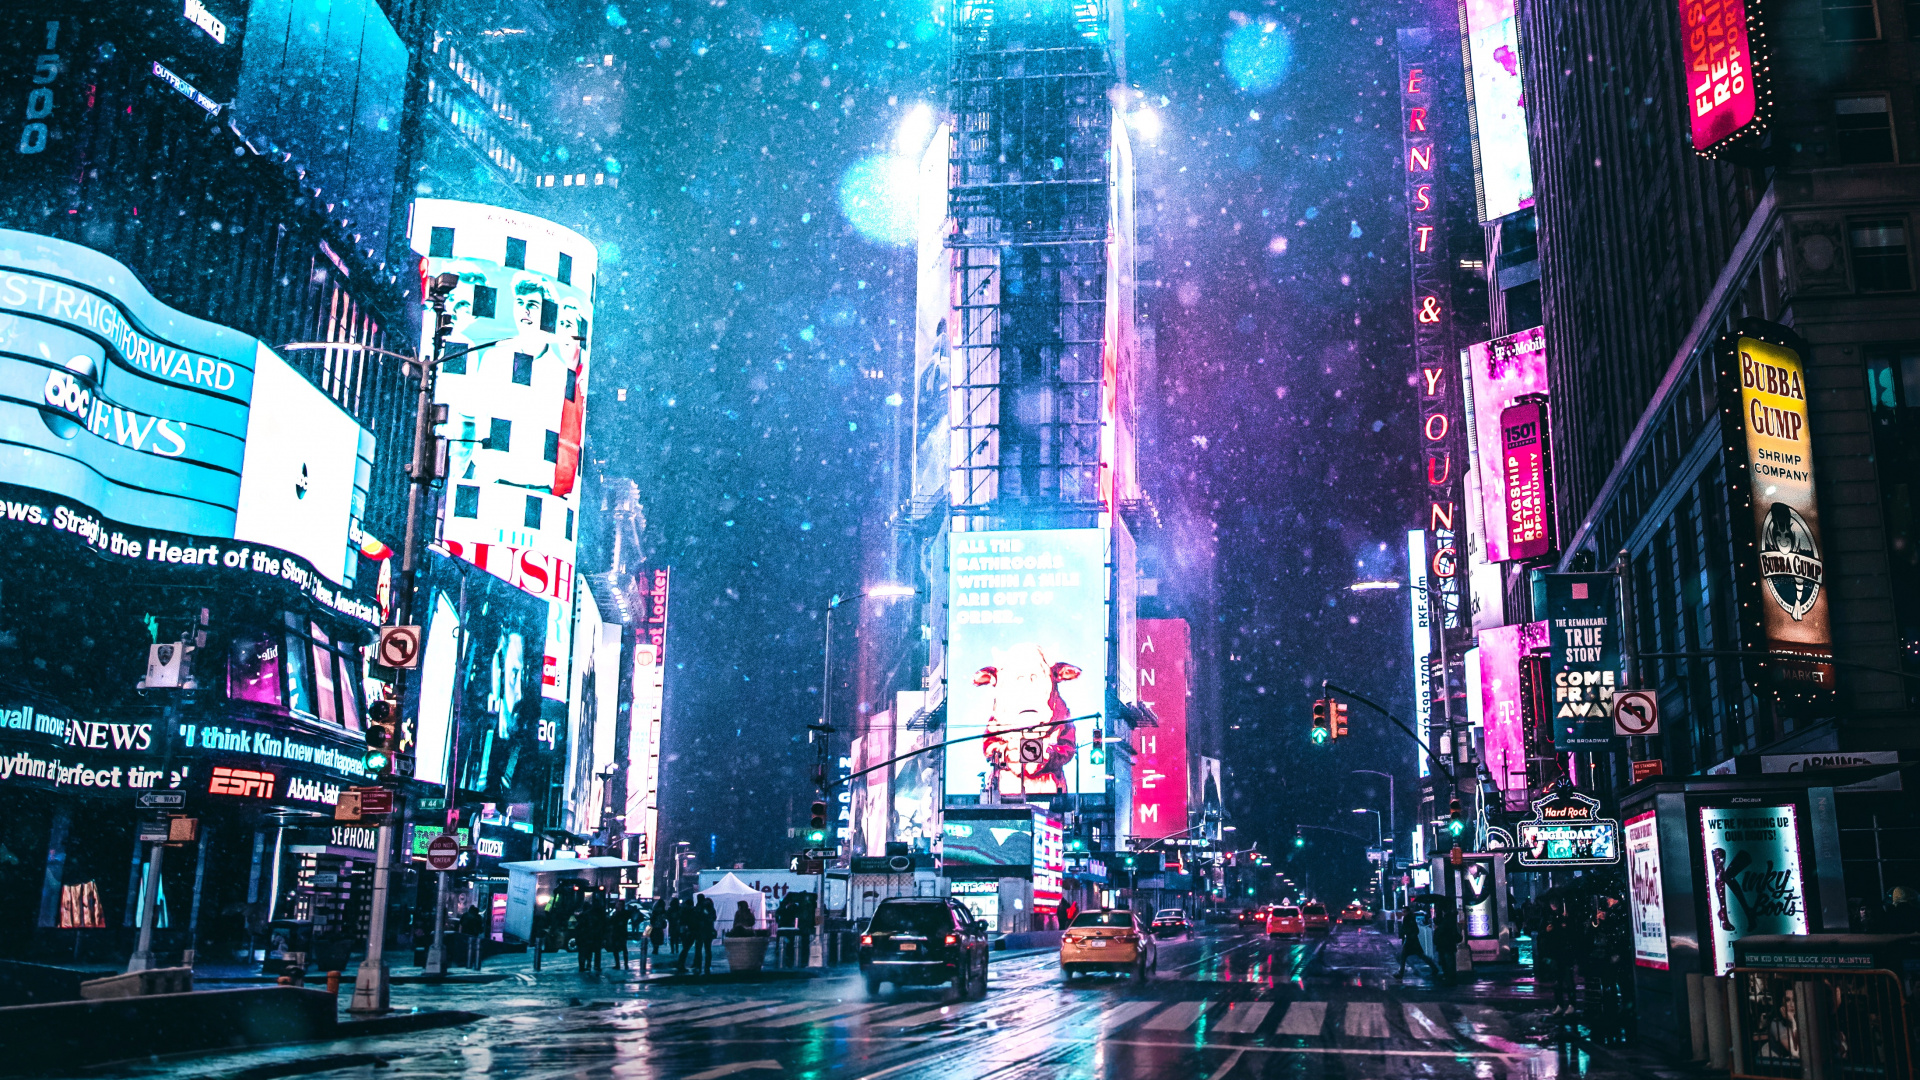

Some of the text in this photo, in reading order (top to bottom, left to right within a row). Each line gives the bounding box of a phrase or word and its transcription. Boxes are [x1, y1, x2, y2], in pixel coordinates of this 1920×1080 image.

[19, 20, 60, 154] 1500
[154, 65, 196, 98] OUTFRONT
[1407, 68, 1456, 578] ERNST & YOUNG
[4, 278, 236, 391] STRAIGHTFORWARD
[1741, 351, 1804, 400] BUBBA
[1751, 398, 1801, 441] GUMP
[1505, 421, 1536, 442] 1501
[1758, 448, 1801, 465] SHRIMP
[1754, 463, 1808, 482] COMPANY
[1508, 456, 1523, 544] FLAGSHIP
[1530, 452, 1543, 539] OPPORTUNITY
[1521, 481, 1535, 541] RETAIL
[0, 500, 48, 525] ews.
[110, 532, 142, 559] the
[147, 539, 217, 565] Heart
[224, 548, 250, 568] of
[252, 552, 280, 575] the
[957, 539, 1023, 553] ALL THE
[957, 553, 1064, 571] BATHROOMS
[1762, 555, 1822, 581] BUBBA GUMP
[956, 574, 1020, 588] WITHIN
[1023, 574, 1036, 588] A
[649, 568, 667, 623] Locker
[956, 590, 1054, 606] ARE OUT OF
[1418, 575, 1429, 628] RKF.com
[1555, 617, 1607, 627] THE REMARKABLE
[1565, 627, 1602, 647] TRUE
[1566, 647, 1602, 662] STORY
[1555, 671, 1614, 686] COME
[1782, 668, 1824, 683] MARKET
[1557, 702, 1614, 718] AWAY
[69, 719, 153, 750] NEWS
[201, 727, 251, 752] think
[253, 732, 282, 757] Kim
[283, 737, 313, 762] knew
[314, 745, 335, 767] what
[208, 766, 276, 799] ESPN
[163, 795, 180, 803] WAY
[1545, 806, 1588, 818] Hard Rock
[1708, 817, 1789, 829] WE'RE PACKING UP
[331, 826, 375, 850] SEPHORA
[1725, 830, 1776, 842] OUR BOOTS!
[1755, 893, 1804, 916] Boots
[1745, 955, 1759, 963] NEW
[1761, 955, 1771, 963] KID
[1785, 955, 1796, 963] THE
[1798, 956, 1818, 964] BLOCK
[1821, 956, 1836, 964] JOEY
